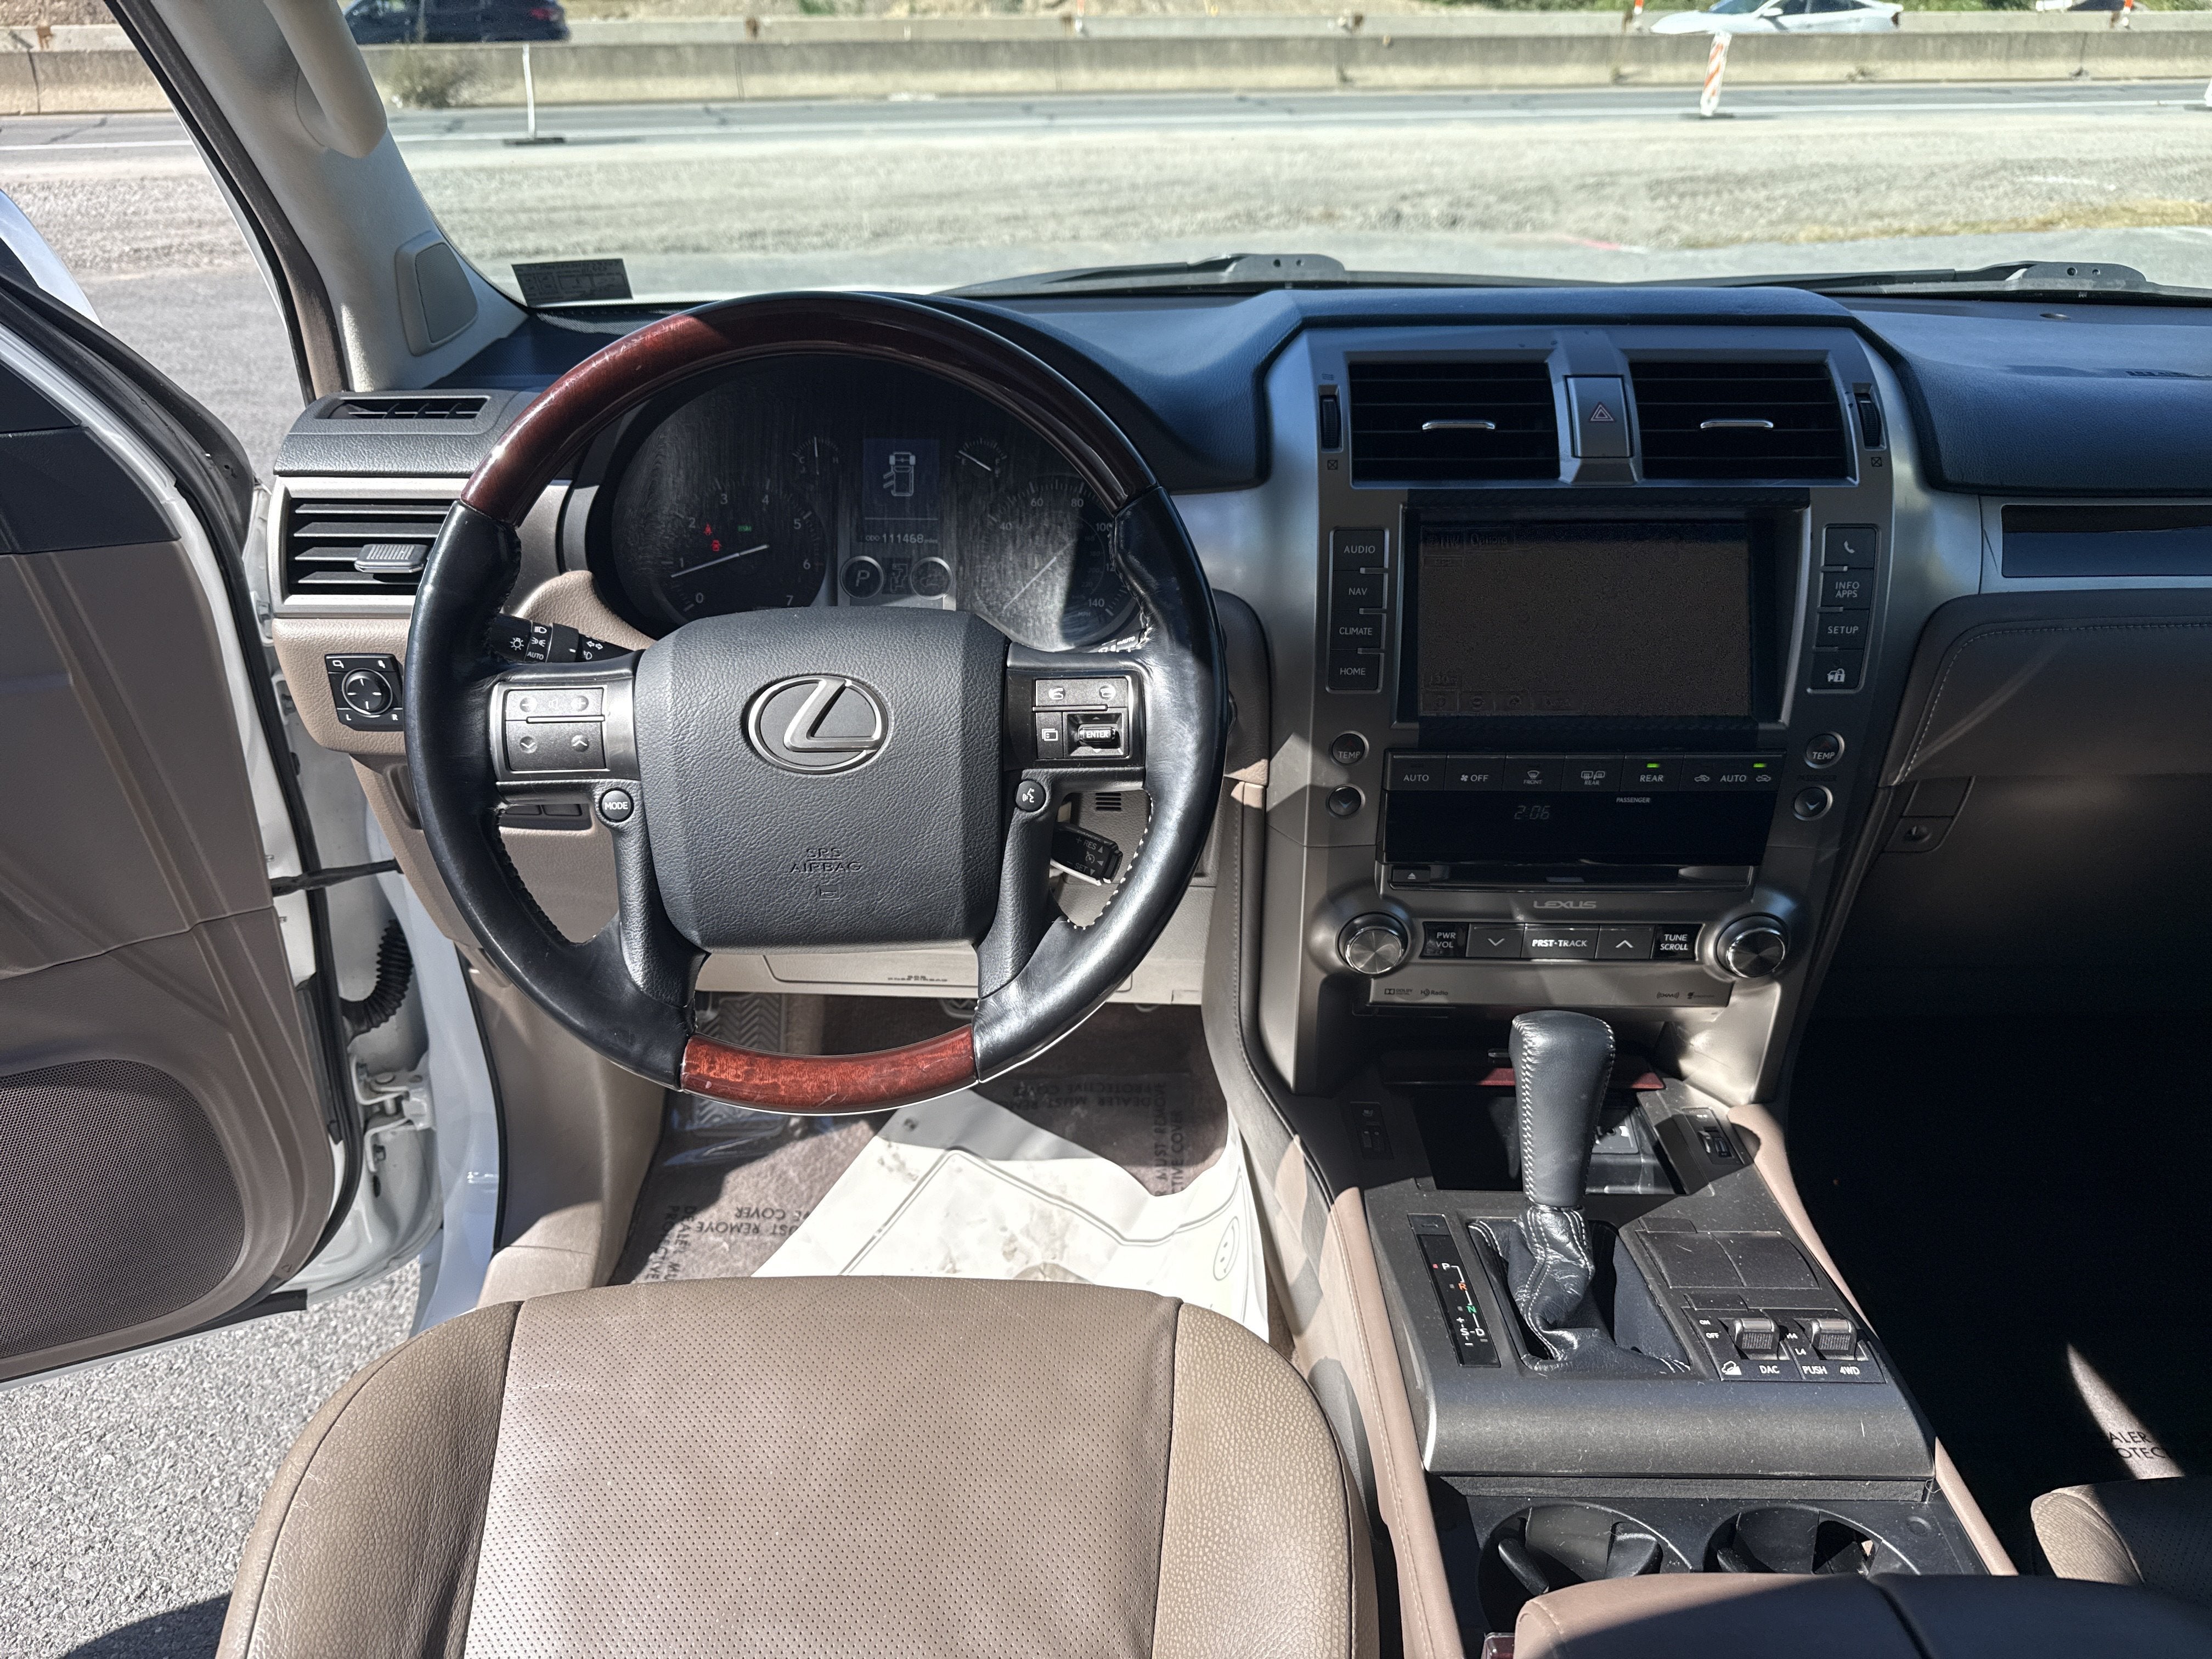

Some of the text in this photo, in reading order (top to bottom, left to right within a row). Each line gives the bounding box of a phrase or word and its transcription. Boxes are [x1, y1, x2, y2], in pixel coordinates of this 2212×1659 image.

[720, 494, 728, 505] 3
[761, 494, 769, 505] 4
[1031, 498, 1043, 507] 60
[1071, 498, 1084, 507] 80
[688, 517, 696, 529] 2
[793, 518, 801, 529] 5
[1000, 523, 1012, 532] 40
[882, 534, 924, 544] 111468
[1344, 545, 1375, 554] AUDIO
[679, 557, 684, 567] 1
[803, 559, 811, 569] 6
[856, 569, 870, 586] P
[1835, 581, 1860, 590] INFO
[1348, 588, 1368, 596] NAV
[1835, 590, 1858, 598] APPS
[695, 592, 704, 603] 0
[786, 595, 793, 606] 7
[1088, 599, 1105, 607] 140
[1339, 627, 1373, 635] CLIMATE
[1827, 626, 1859, 634] SETUP
[527, 651, 544, 661] AUTO
[1339, 668, 1366, 676] HOME
[1086, 730, 1109, 738] ENTER
[1338, 751, 1361, 759] TEMP
[1813, 752, 1835, 760] TEMP
[1403, 774, 1429, 782] AUTO
[1470, 774, 1488, 782] OFF
[1639, 774, 1664, 782] REAR
[1720, 774, 1747, 782] AUTO
[604, 801, 628, 810] MODE
[1083, 839, 1097, 850] RES
[806, 848, 842, 859] SRS
[790, 862, 862, 873] AIRBAG
[1074, 862, 1088, 872] SET
[1533, 900, 1596, 910] LEXUS
[735, 1206, 786, 1221] COVER
[696, 1221, 761, 1235] REMOVE
[1441, 1262, 1450, 1271] P
[1458, 1283, 1468, 1291] R
[1460, 1327, 1485, 1336] S D
[1759, 1365, 1780, 1374] DAC
[1802, 1365, 1860, 1375] PUSH 4WD
